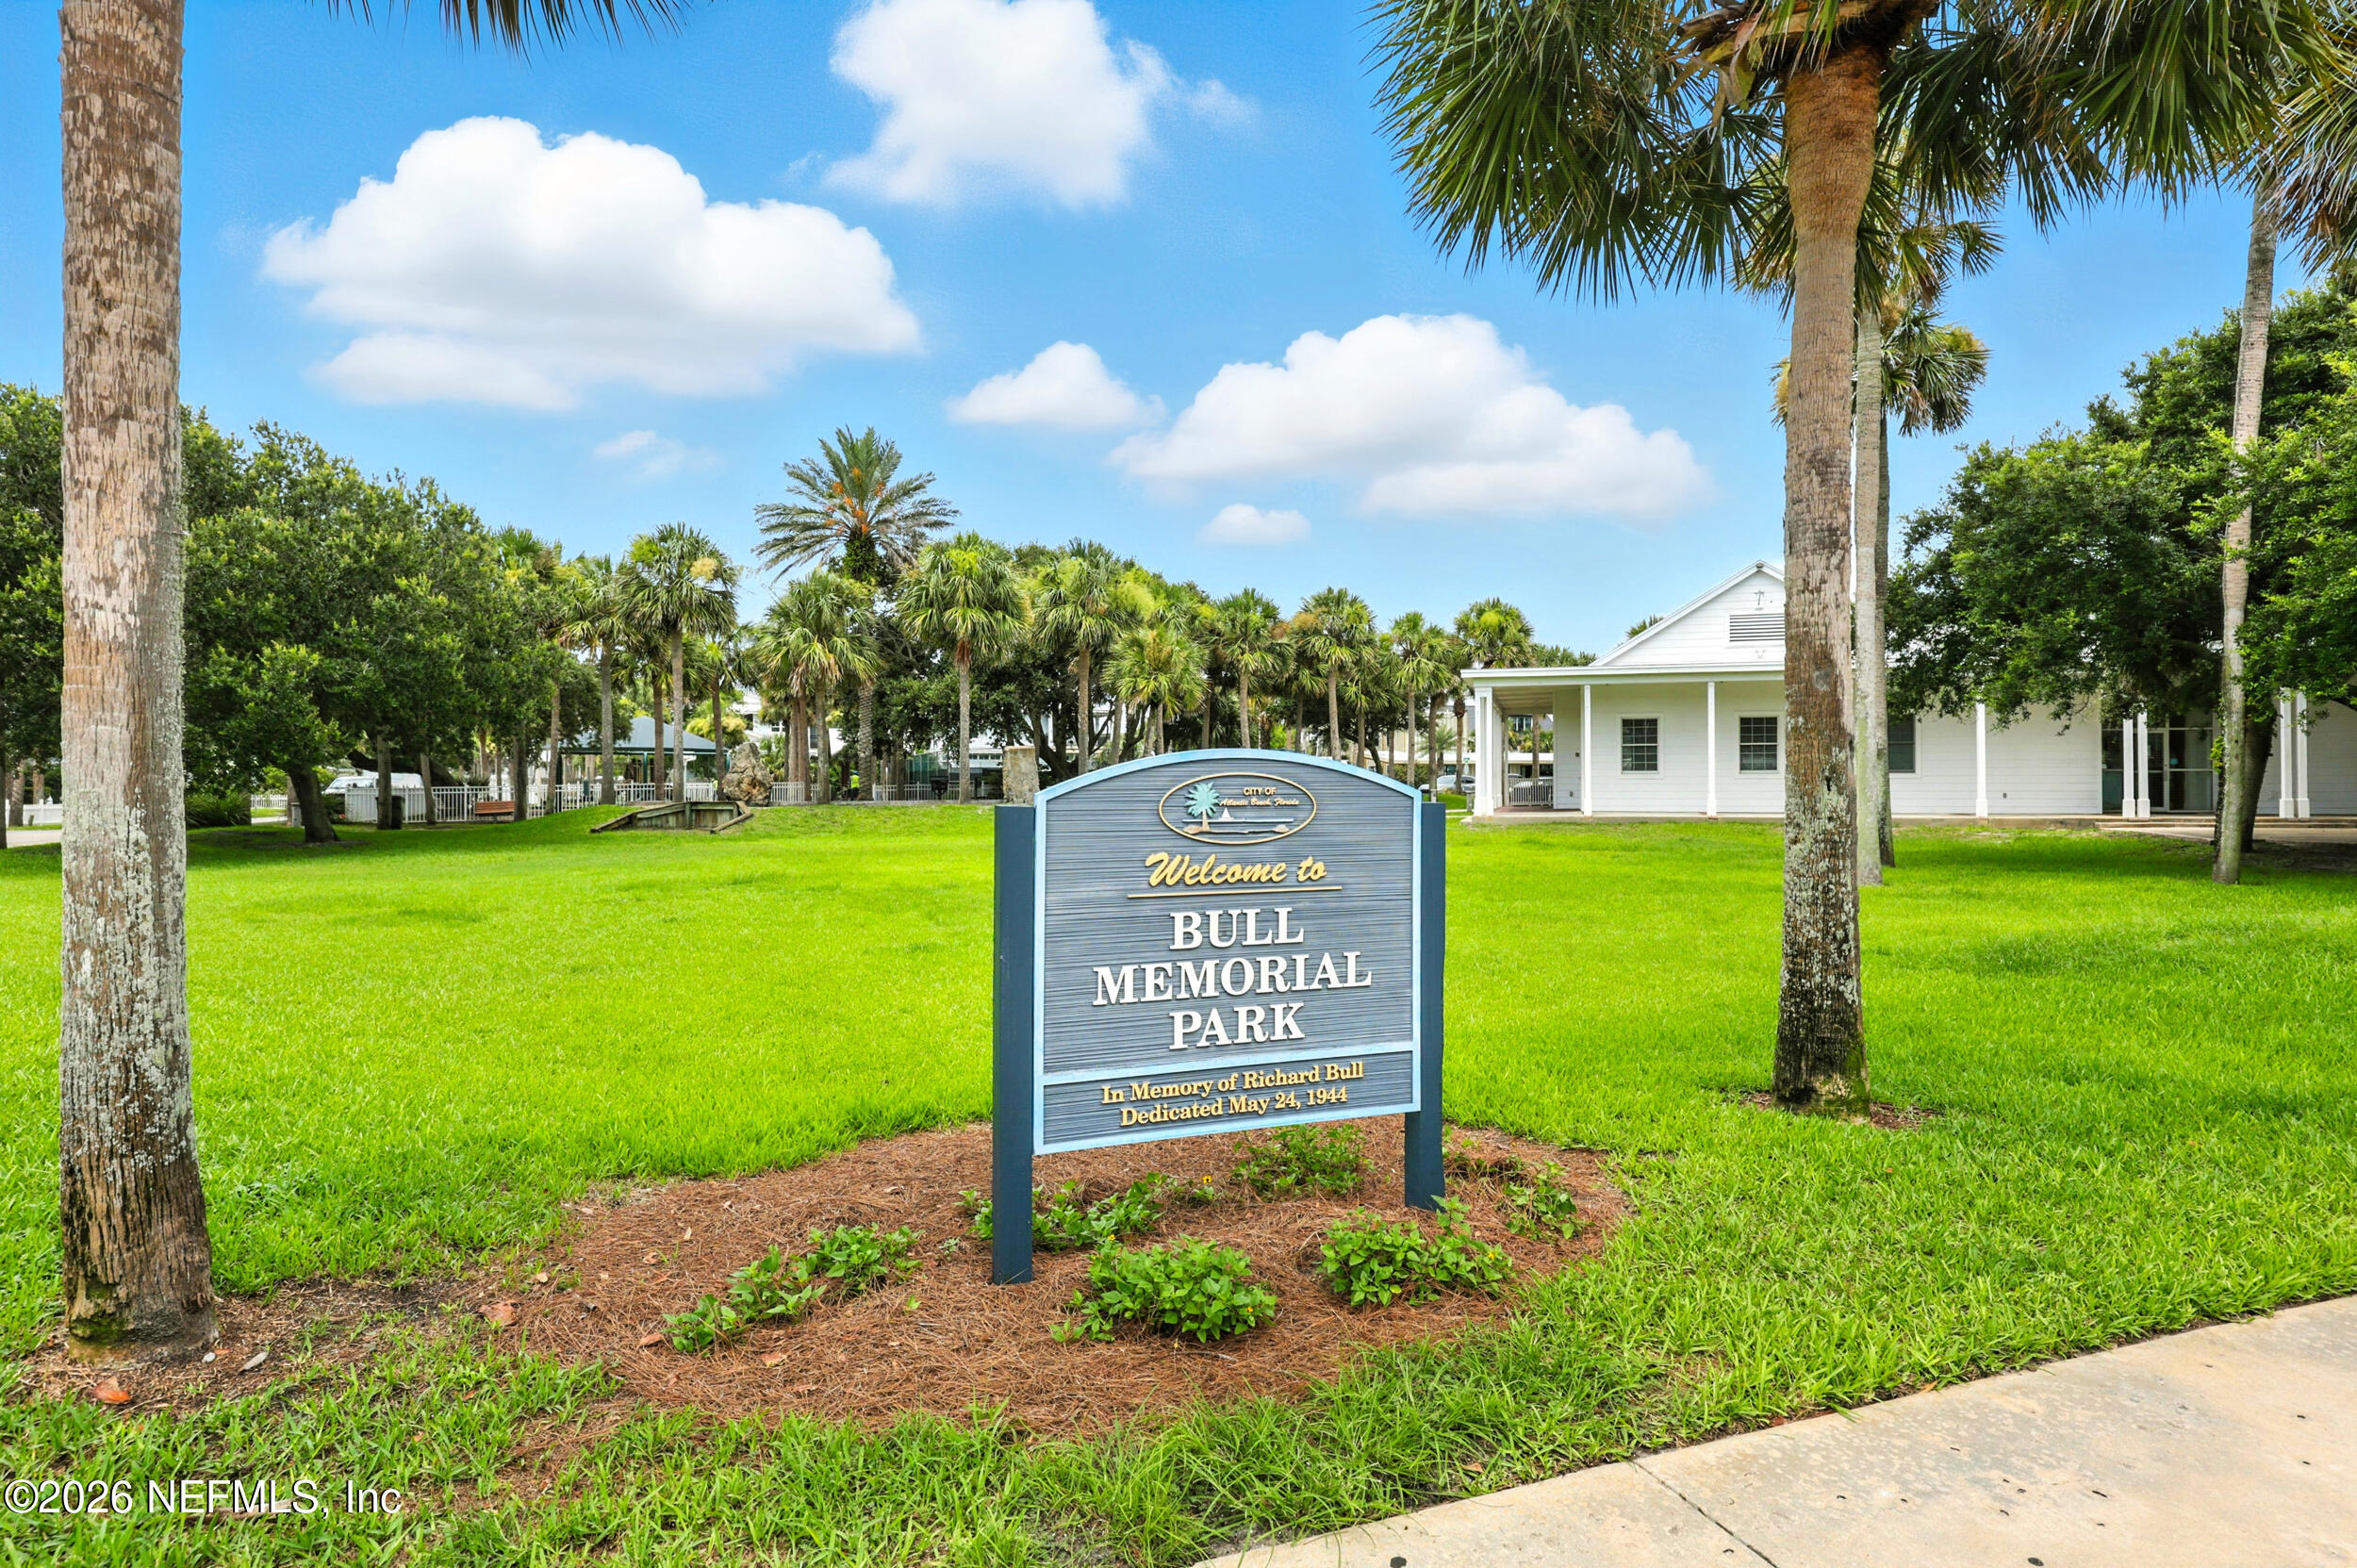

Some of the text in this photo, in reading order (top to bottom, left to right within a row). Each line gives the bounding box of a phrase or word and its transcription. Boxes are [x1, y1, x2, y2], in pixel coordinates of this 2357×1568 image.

[1244, 786, 1277, 796] CITY OF
[1145, 851, 1327, 886] Welcome to
[1169, 907, 1305, 950] BULL
[1092, 951, 1373, 1006] MEMORIAL
[1168, 1002, 1306, 1050] PARK
[1101, 1062, 1364, 1104] In Memory of Richard Bull
[1120, 1086, 1348, 1127] Dedicated May 24, 1944
